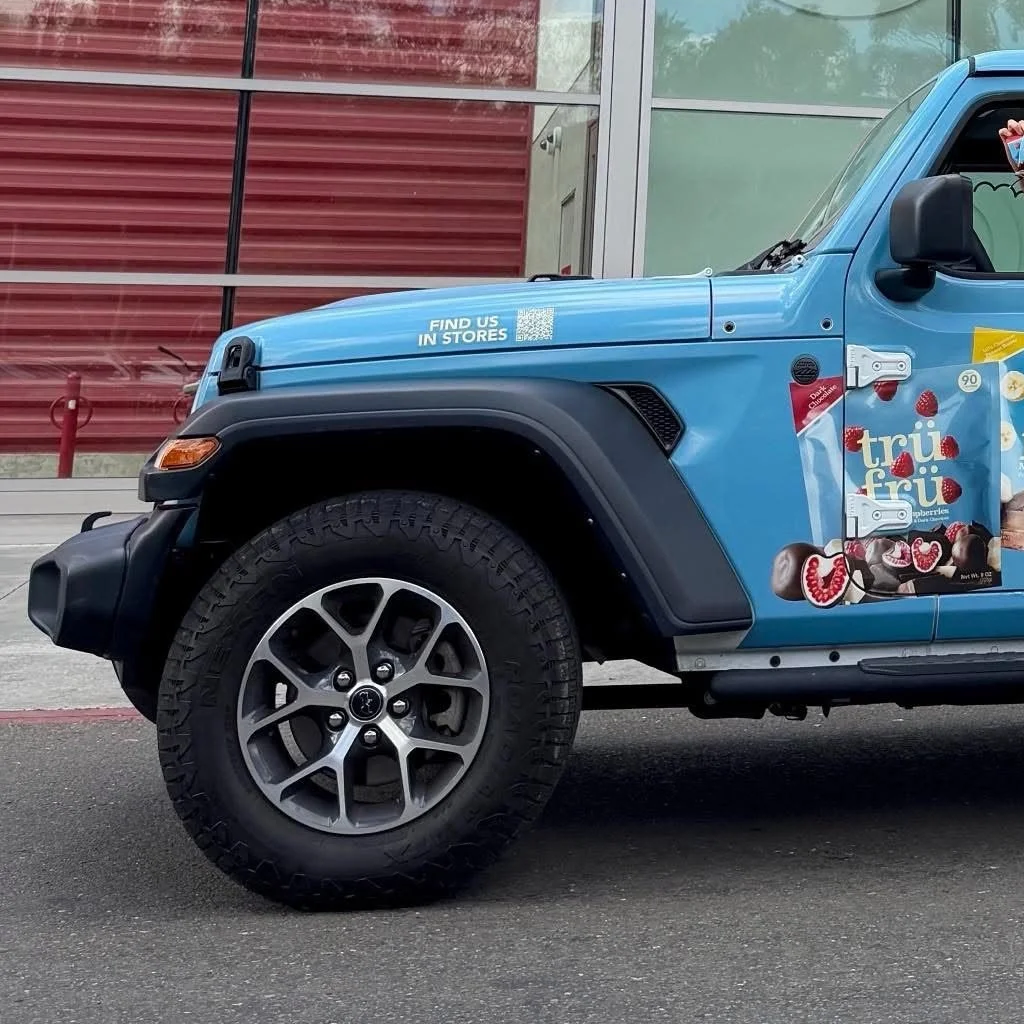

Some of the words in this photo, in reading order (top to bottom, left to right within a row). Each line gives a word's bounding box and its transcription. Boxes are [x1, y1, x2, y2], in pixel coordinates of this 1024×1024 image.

[429, 317, 471, 332] FIND
[477, 315, 499, 328] US
[418, 333, 437, 347] IN
[442, 327, 508, 345] STORES
[961, 374, 978, 386] 90
[808, 384, 838, 409] Chocolate
[809, 385, 827, 400] Dark
[857, 419, 946, 469] trü
